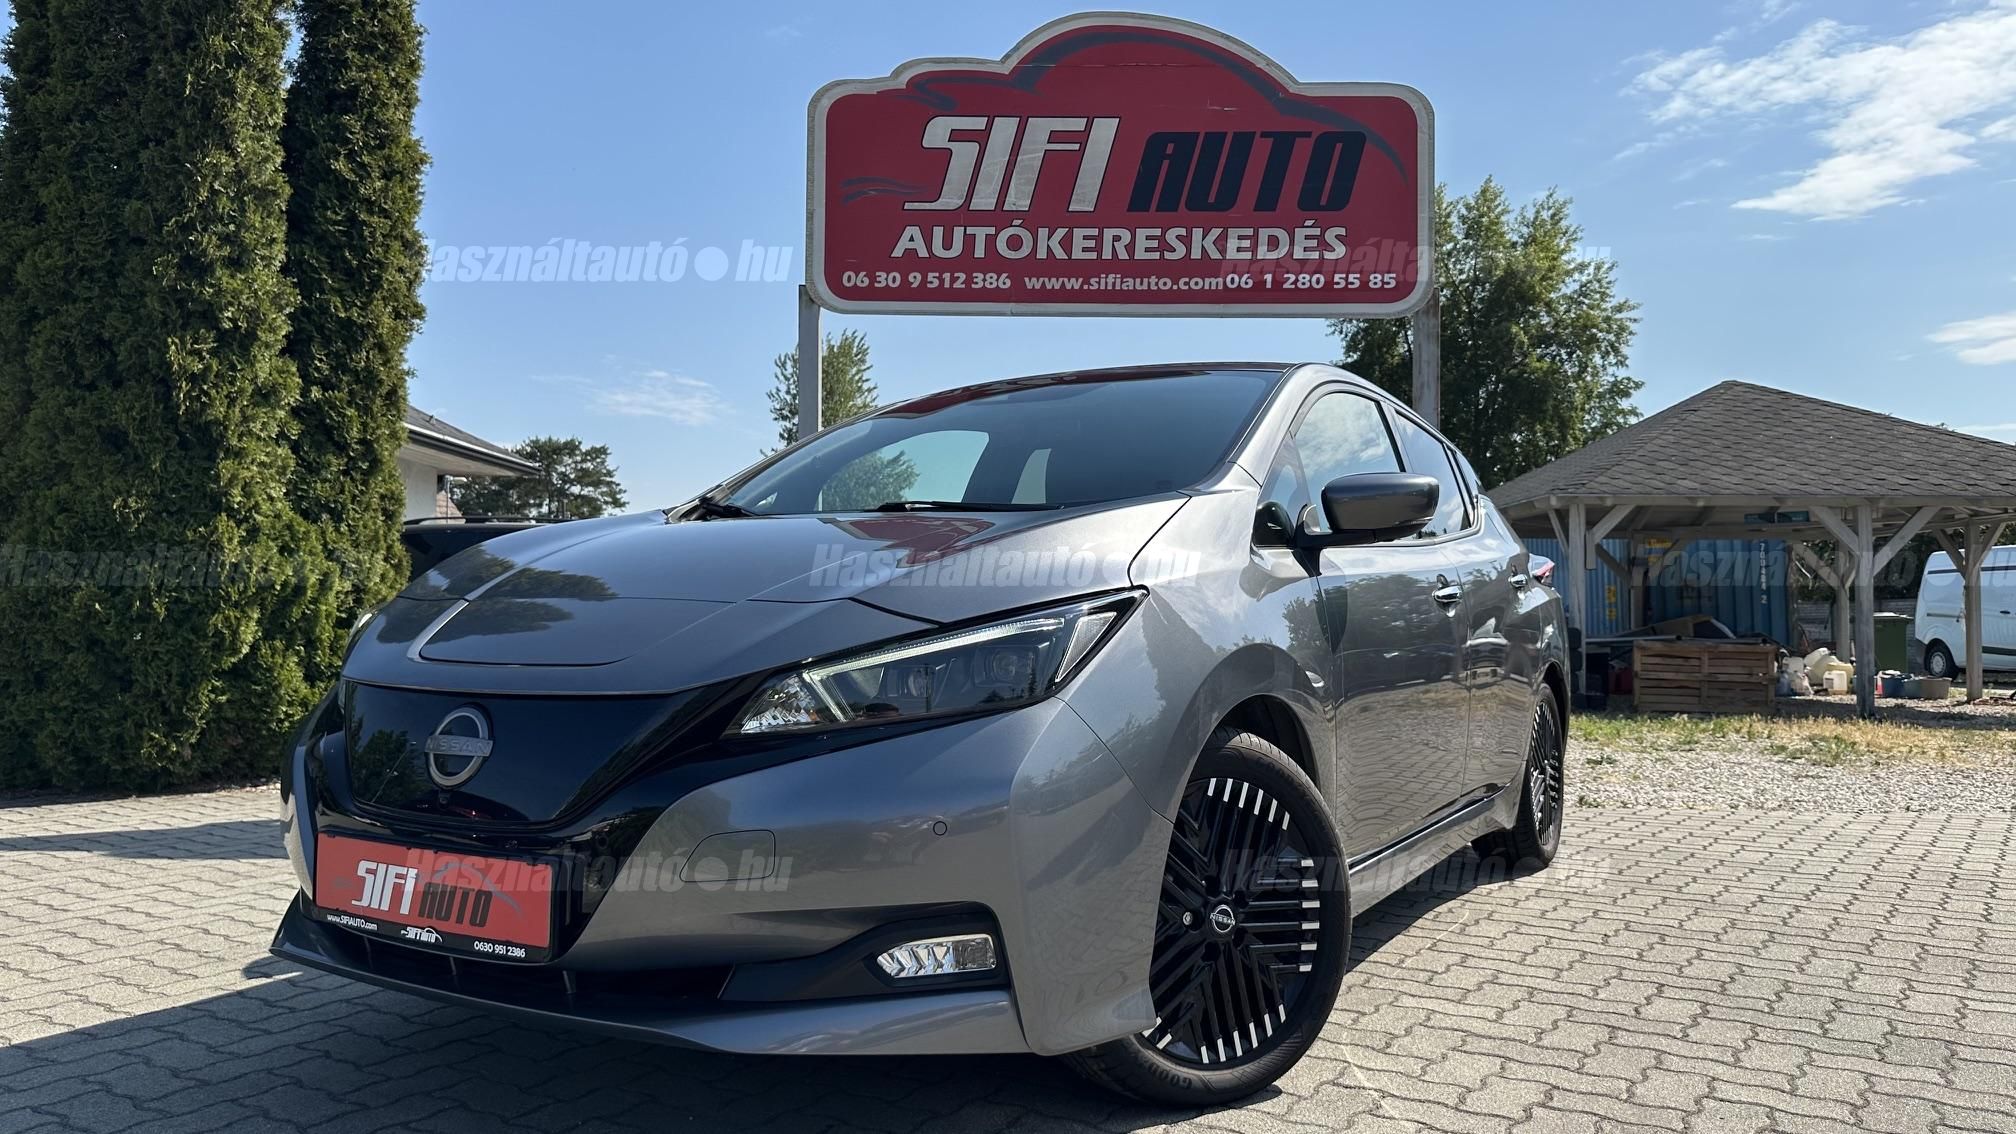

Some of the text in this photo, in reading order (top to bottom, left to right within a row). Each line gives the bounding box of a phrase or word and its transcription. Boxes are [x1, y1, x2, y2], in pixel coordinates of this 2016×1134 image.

[902, 115, 1368, 213] SIFI AUTO
[889, 218, 1348, 261] AUTÓKERESKEDÉS
[842, 271, 870, 288] 06
[874, 271, 901, 288] 30
[971, 273, 1012, 289] 386
[1023, 273, 1224, 290] www.sifiauto.com
[1225, 273, 1253, 289] 06
[1263, 274, 1273, 288] 1
[1282, 273, 1325, 289] 280
[1333, 273, 1360, 288] 55
[1368, 273, 1397, 289] 85
[426, 736, 491, 755] NISSAN
[417, 881, 493, 928] AUTO
[1210, 913, 1236, 926] NISSAN
[473, 940, 526, 958] 0630 951 2386
